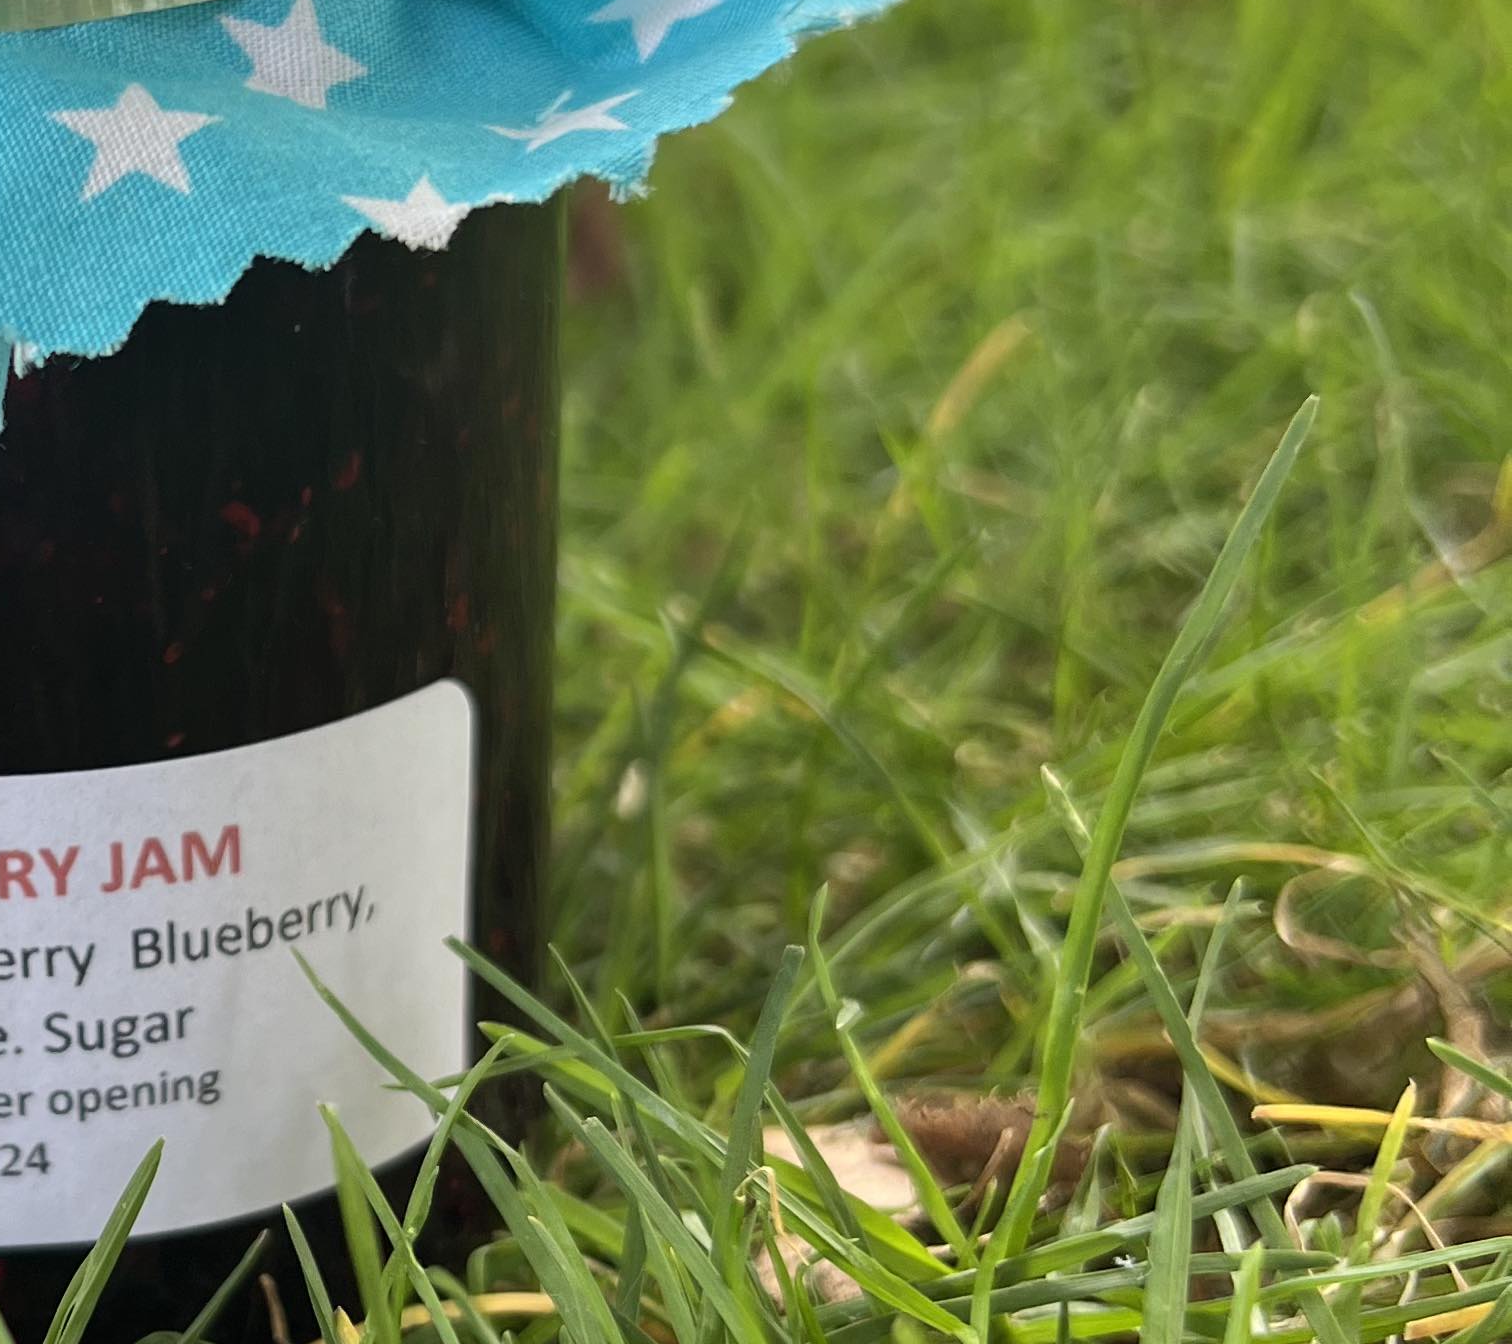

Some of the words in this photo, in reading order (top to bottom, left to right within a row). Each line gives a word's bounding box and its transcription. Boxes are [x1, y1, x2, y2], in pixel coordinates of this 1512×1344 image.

[99, 824, 242, 893] JAM
[131, 884, 376, 971] Blueberry,
[44, 1004, 194, 1057] Sugar
[47, 1068, 223, 1122] opening
